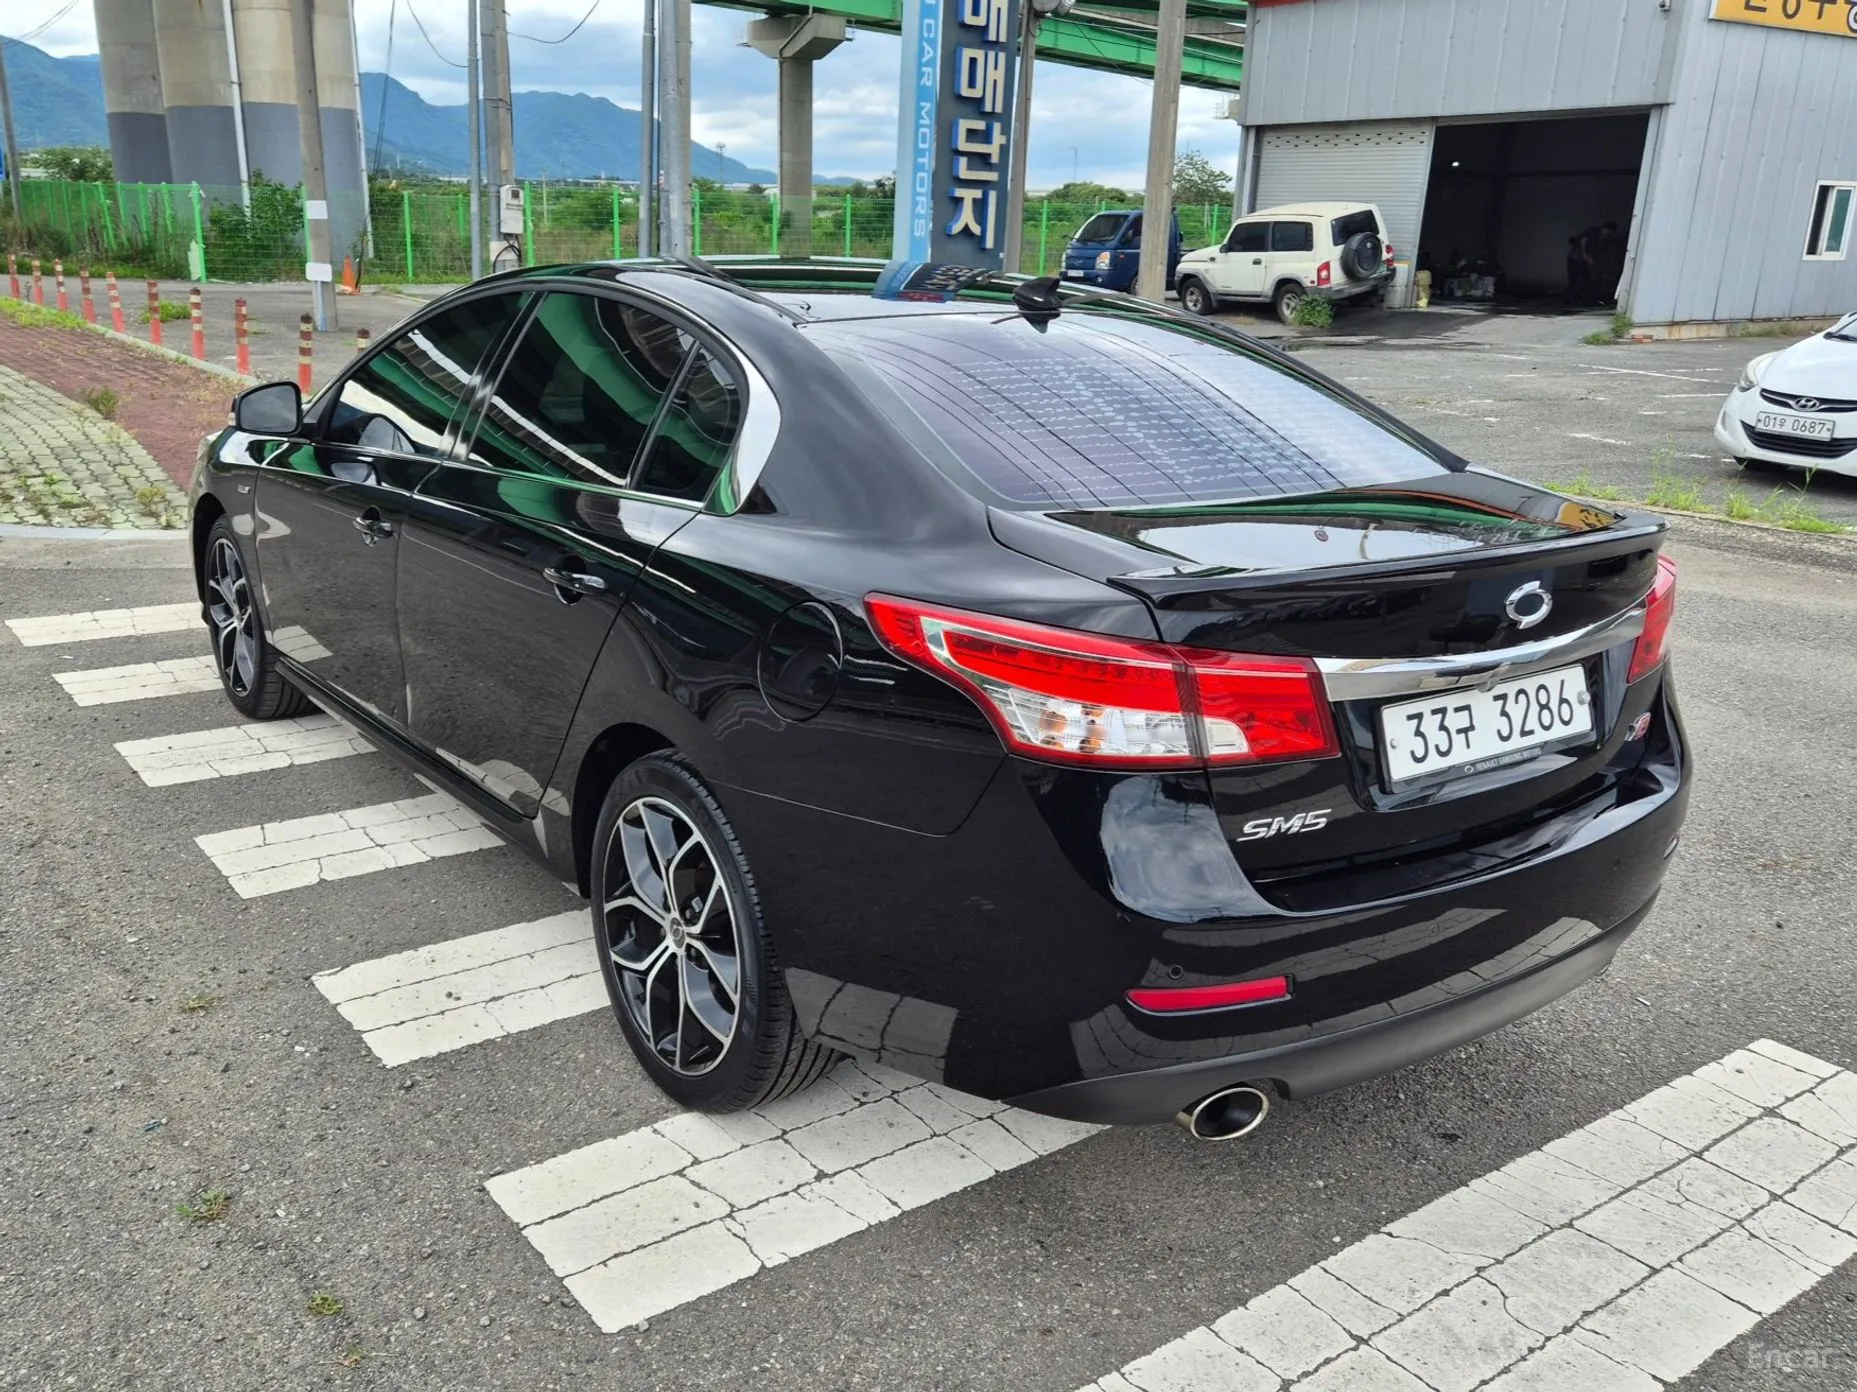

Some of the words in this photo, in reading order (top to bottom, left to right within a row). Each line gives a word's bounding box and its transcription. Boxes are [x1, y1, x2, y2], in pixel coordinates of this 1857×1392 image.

[920, 18, 936, 87] CAR
[914, 101, 932, 238] MOTORS
[1792, 419, 1826, 434] 0687
[1406, 704, 1476, 764] 33구
[1493, 679, 1574, 742] 3286
[1236, 808, 1333, 842] SM5
